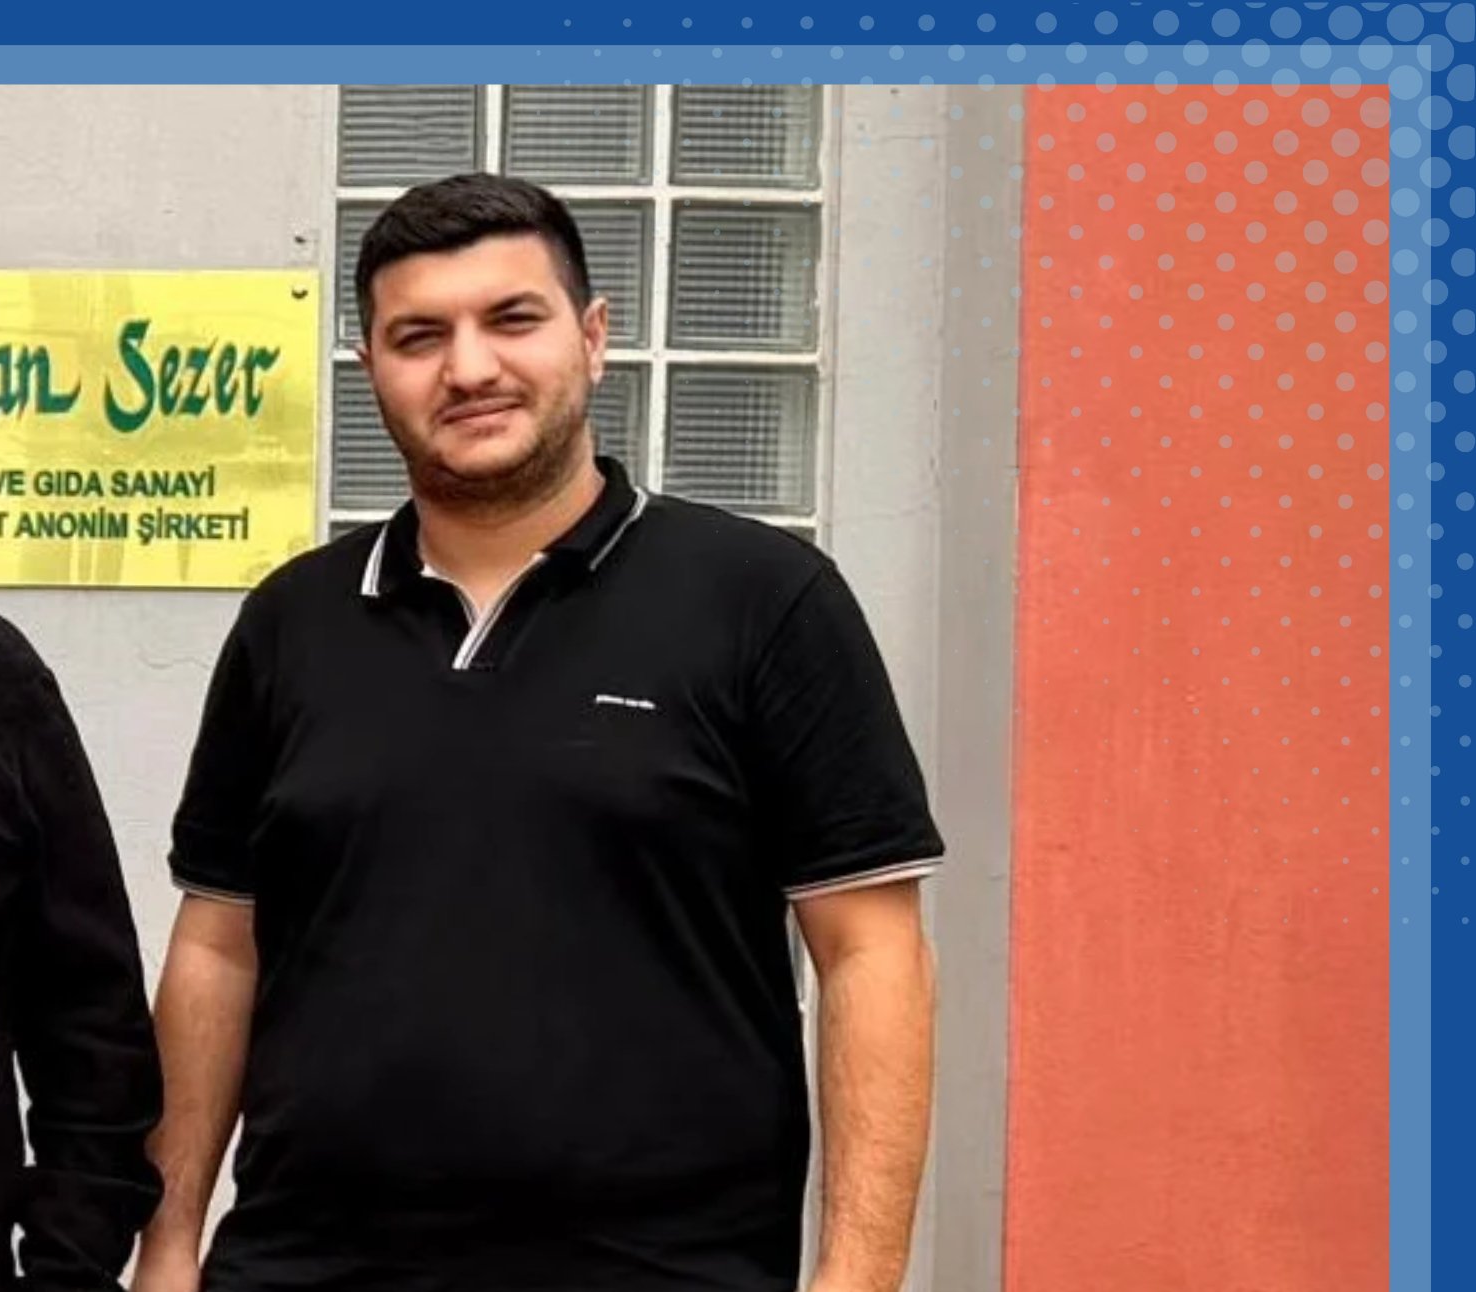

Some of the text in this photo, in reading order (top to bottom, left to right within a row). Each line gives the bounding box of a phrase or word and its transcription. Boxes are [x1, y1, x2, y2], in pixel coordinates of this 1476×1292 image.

[104, 319, 280, 434] Sezer
[33, 470, 104, 498] GIDA
[110, 465, 215, 498] SANAYİ
[14, 507, 129, 540] ANONİM
[136, 507, 250, 545] ŞİRKETİ
